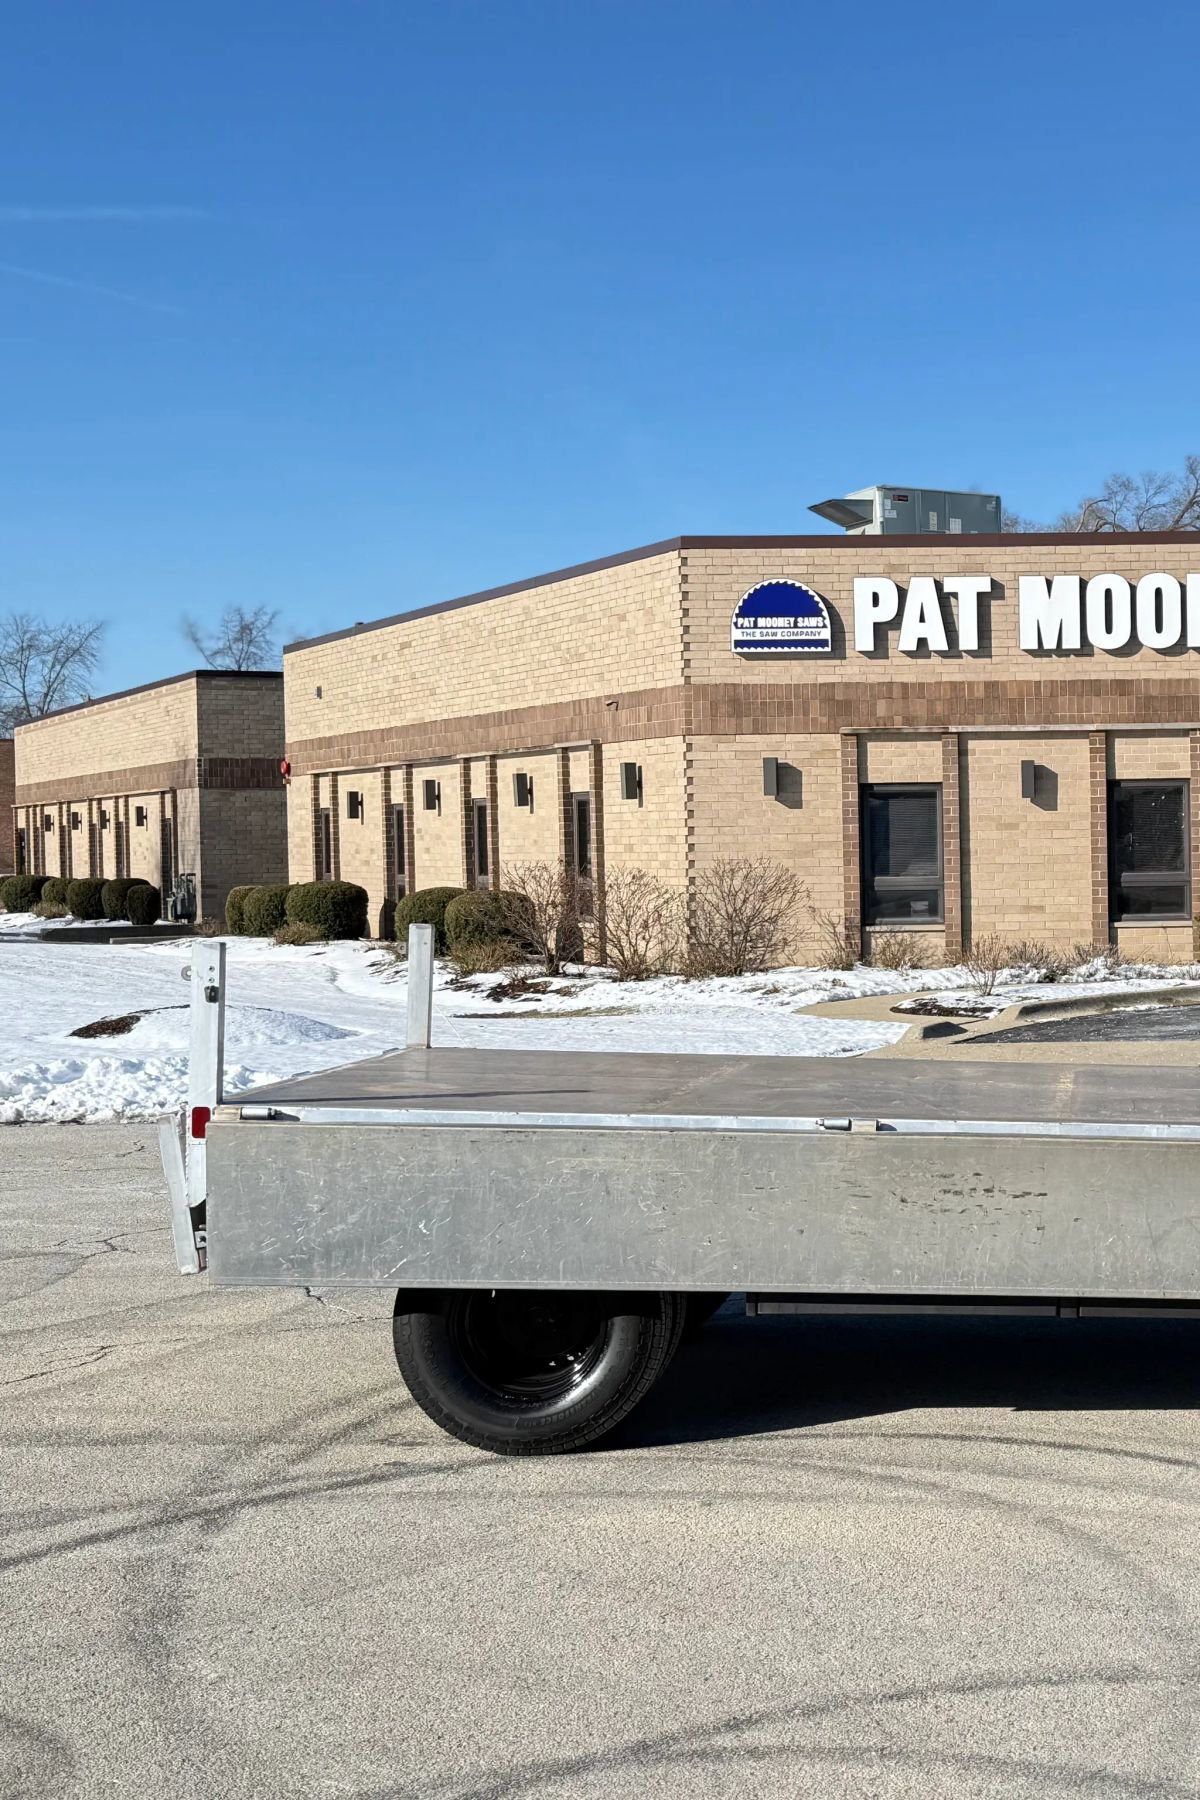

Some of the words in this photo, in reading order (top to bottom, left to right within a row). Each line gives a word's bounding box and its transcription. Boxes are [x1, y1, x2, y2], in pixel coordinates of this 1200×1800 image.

[737, 617, 755, 628] PAT
[757, 616, 795, 628] MOONEY
[797, 616, 823, 627] SAWS
[853, 576, 991, 651] PAT
